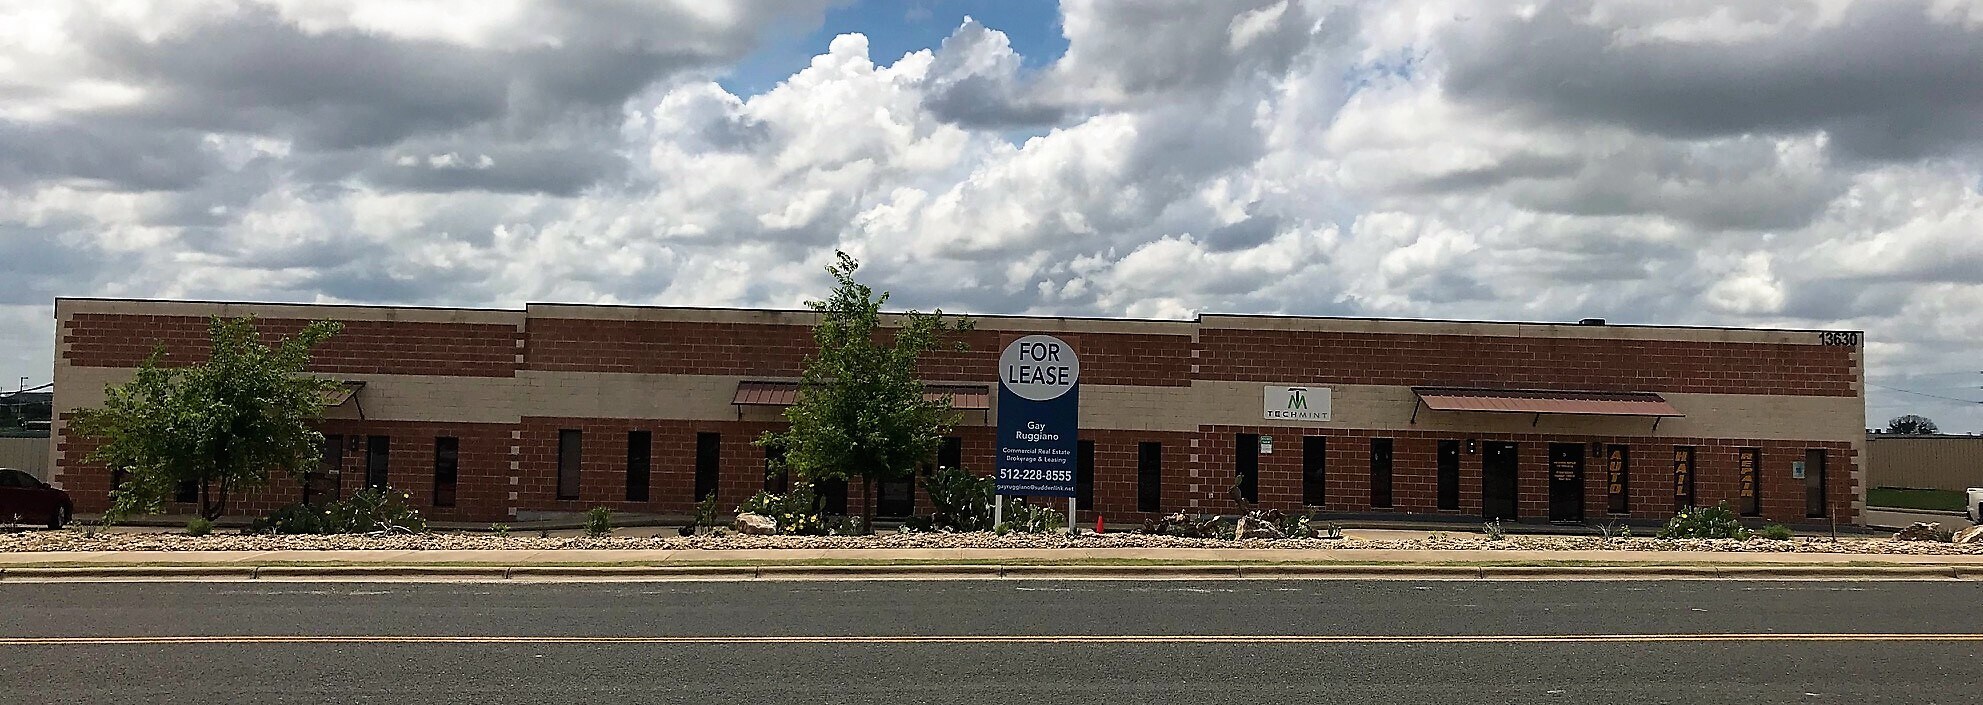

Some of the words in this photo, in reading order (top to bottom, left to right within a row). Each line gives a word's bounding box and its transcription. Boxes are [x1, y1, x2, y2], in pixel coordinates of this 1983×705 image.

[1818, 331, 1858, 346] 13630
[1020, 342, 1060, 362] FOR
[1008, 365, 1069, 385] LEASE
[1267, 410, 1328, 419] TECHMINT
[1027, 421, 1046, 432] Gay
[1015, 431, 1059, 442] Ruggiano
[1006, 455, 1037, 463] Brokerage
[1044, 456, 1067, 464] Leasing
[1000, 468, 1072, 481] 512-228-8555
[1609, 450, 1622, 494] AUTO
[1674, 451, 1688, 496] HAIL
[1740, 453, 1754, 497] REPAIR
